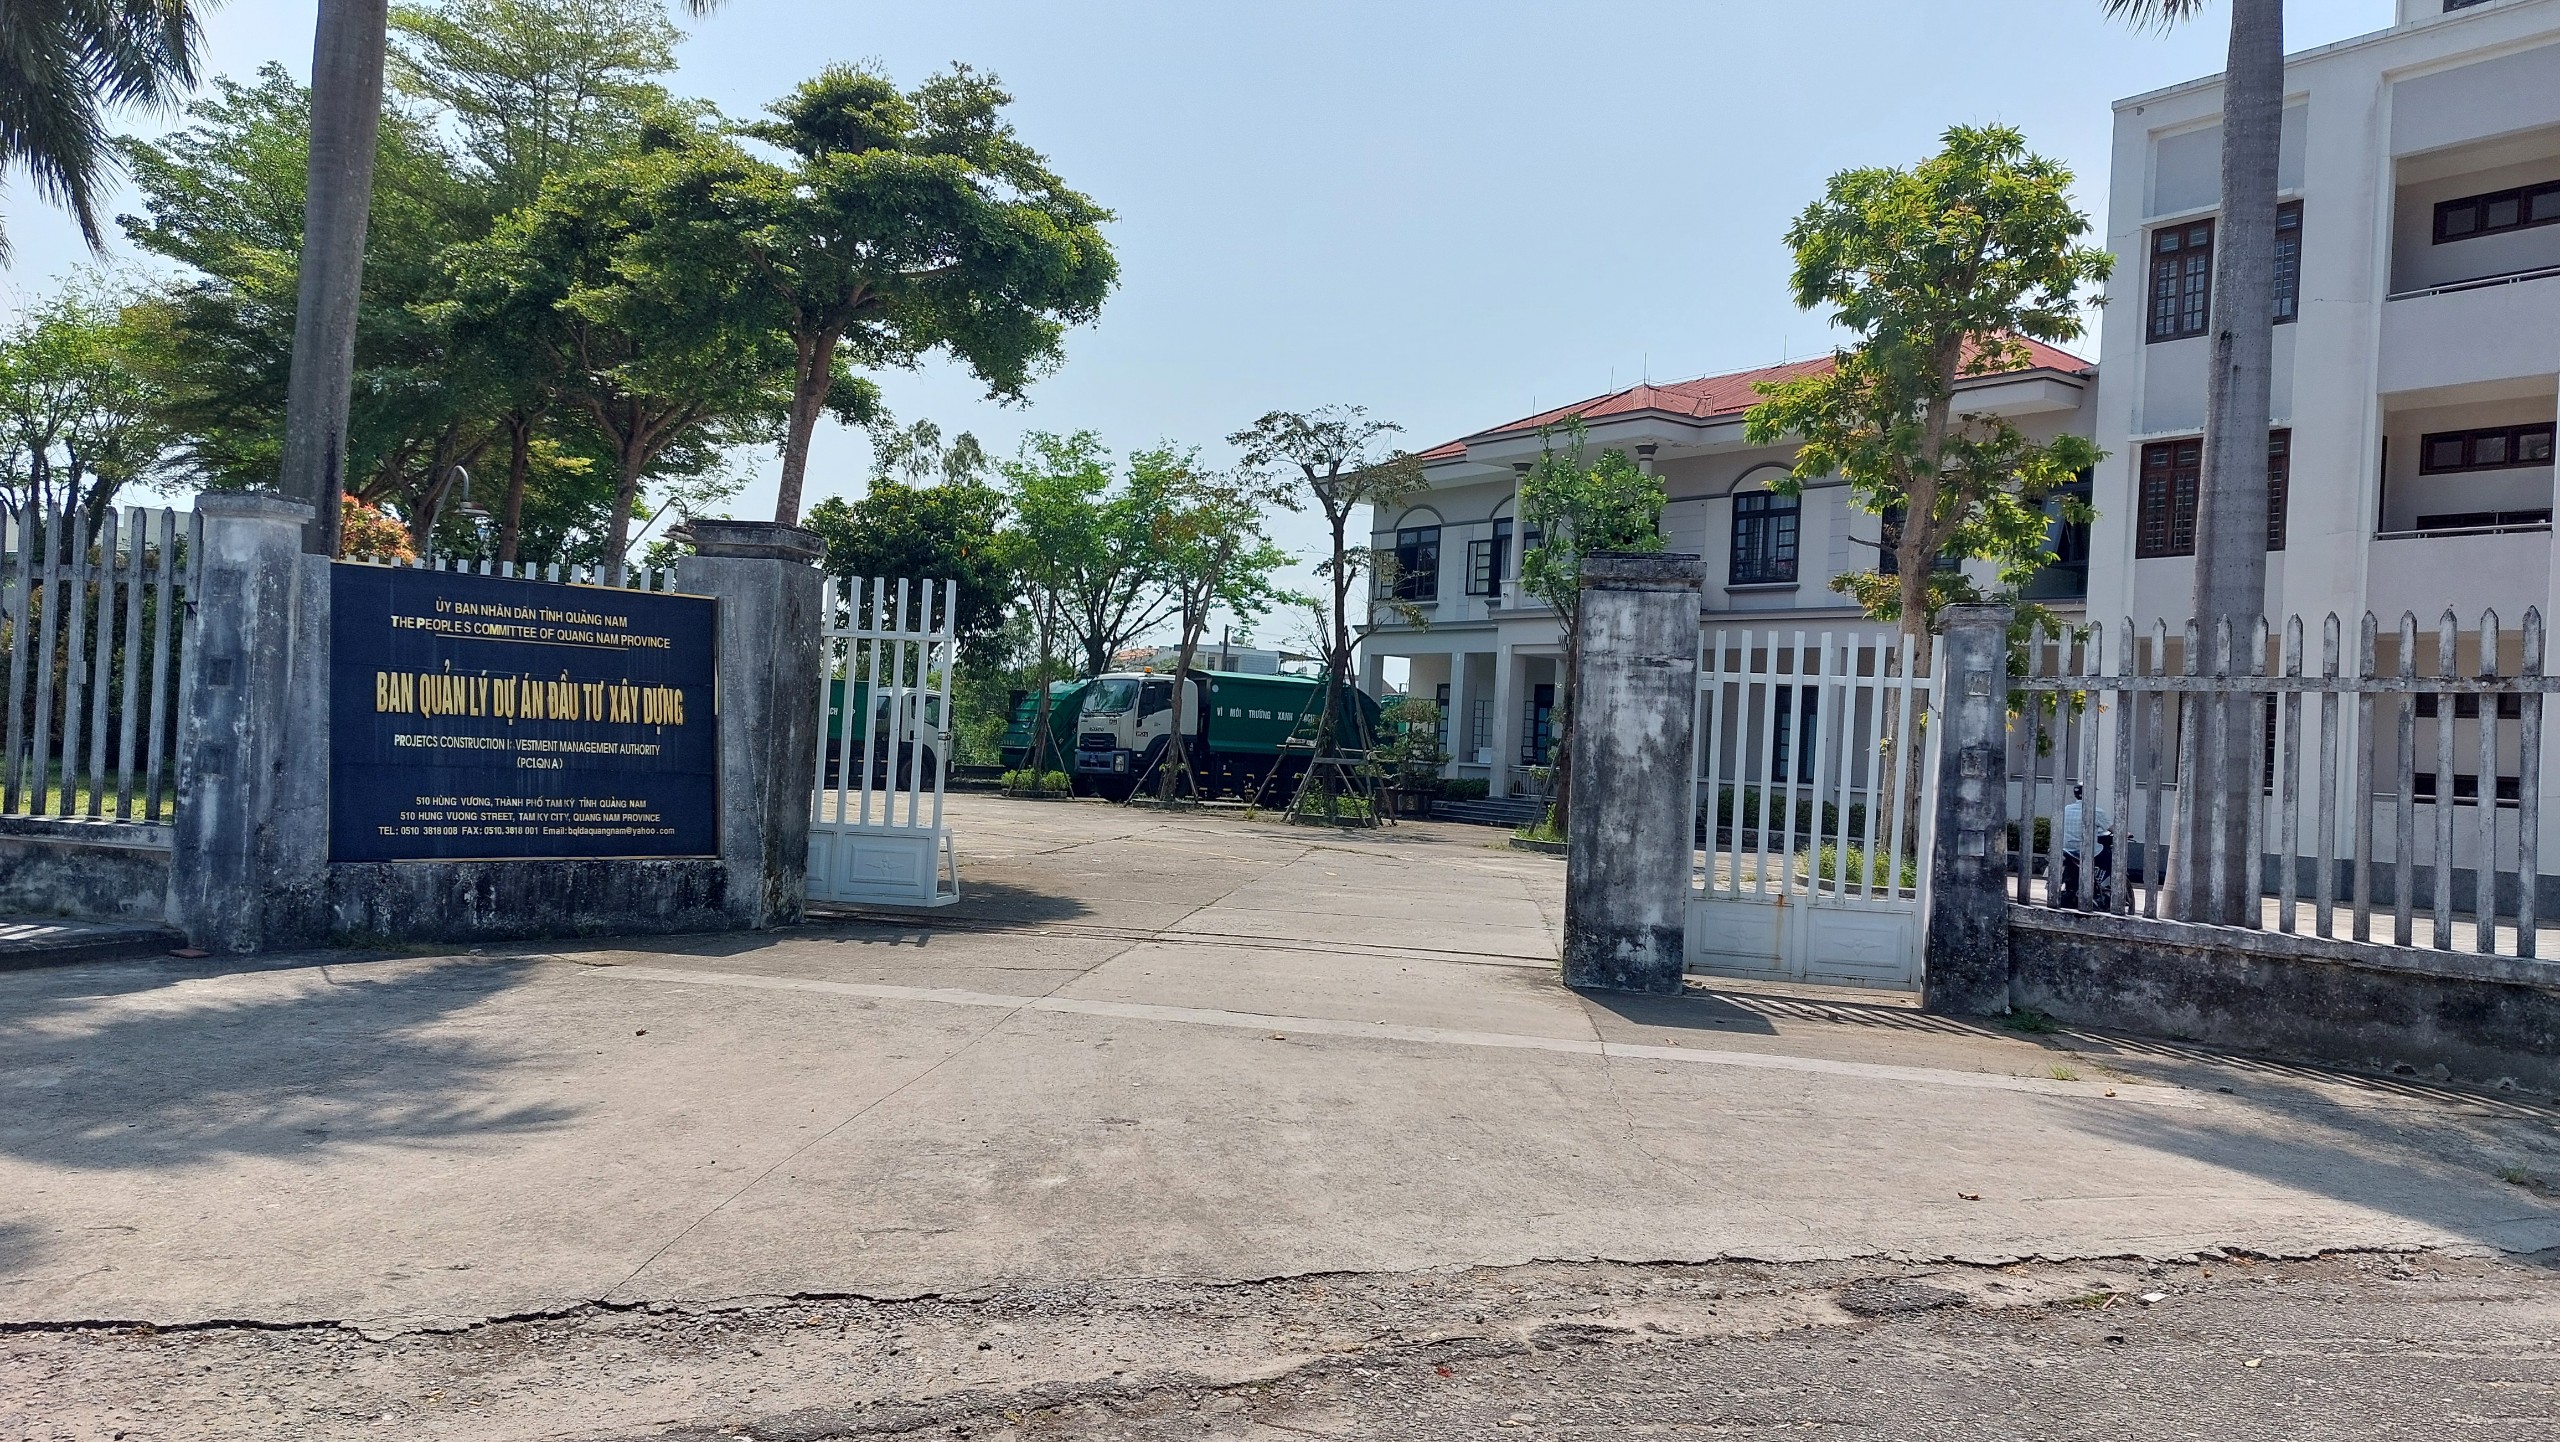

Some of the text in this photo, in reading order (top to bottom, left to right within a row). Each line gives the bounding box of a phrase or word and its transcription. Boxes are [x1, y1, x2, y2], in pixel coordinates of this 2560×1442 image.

[435, 596, 452, 613] ỦY
[454, 602, 478, 616] BAN
[480, 603, 512, 618] NHÂN
[513, 605, 537, 621] DÂN
[604, 615, 628, 628] NAM
[390, 615, 415, 629] THE
[473, 623, 538, 639] COMMITTEE
[539, 627, 555, 640] OF
[556, 629, 594, 643] QUANG
[596, 632, 619, 645] NAM
[620, 634, 671, 649] PROVINCE
[376, 658, 684, 735] BAN QUẢN LÝ DỰ ÁN ĐẦU TƯ XÂY DỰNG
[1277, 711, 1294, 721] XANH
[394, 734, 438, 748] PROJETCS
[440, 736, 505, 751] CONSTRUCTION
[559, 741, 619, 754] MANAGEMENT
[619, 743, 661, 756] AUTHORITY
[415, 796, 431, 806] 510
[432, 794, 457, 807] HÙNG
[494, 795, 524, 808] THÀNH
[545, 799, 563, 808] TAM
[629, 800, 647, 808] NAM
[400, 811, 416, 821] 510
[418, 811, 443, 821] HUNG
[446, 811, 478, 821] VUONG
[480, 812, 516, 822] STREET,
[518, 812, 536, 821] TAM
[537, 812, 549, 821] KY
[573, 813, 602, 822] QUANG
[602, 813, 621, 822] NAM
[622, 813, 661, 822] PROVINCE
[378, 826, 399, 835] TEL:
[400, 826, 420, 835] 0510
[422, 826, 442, 835] 3818
[442, 826, 458, 835] 008
[524, 826, 539, 835] 001
